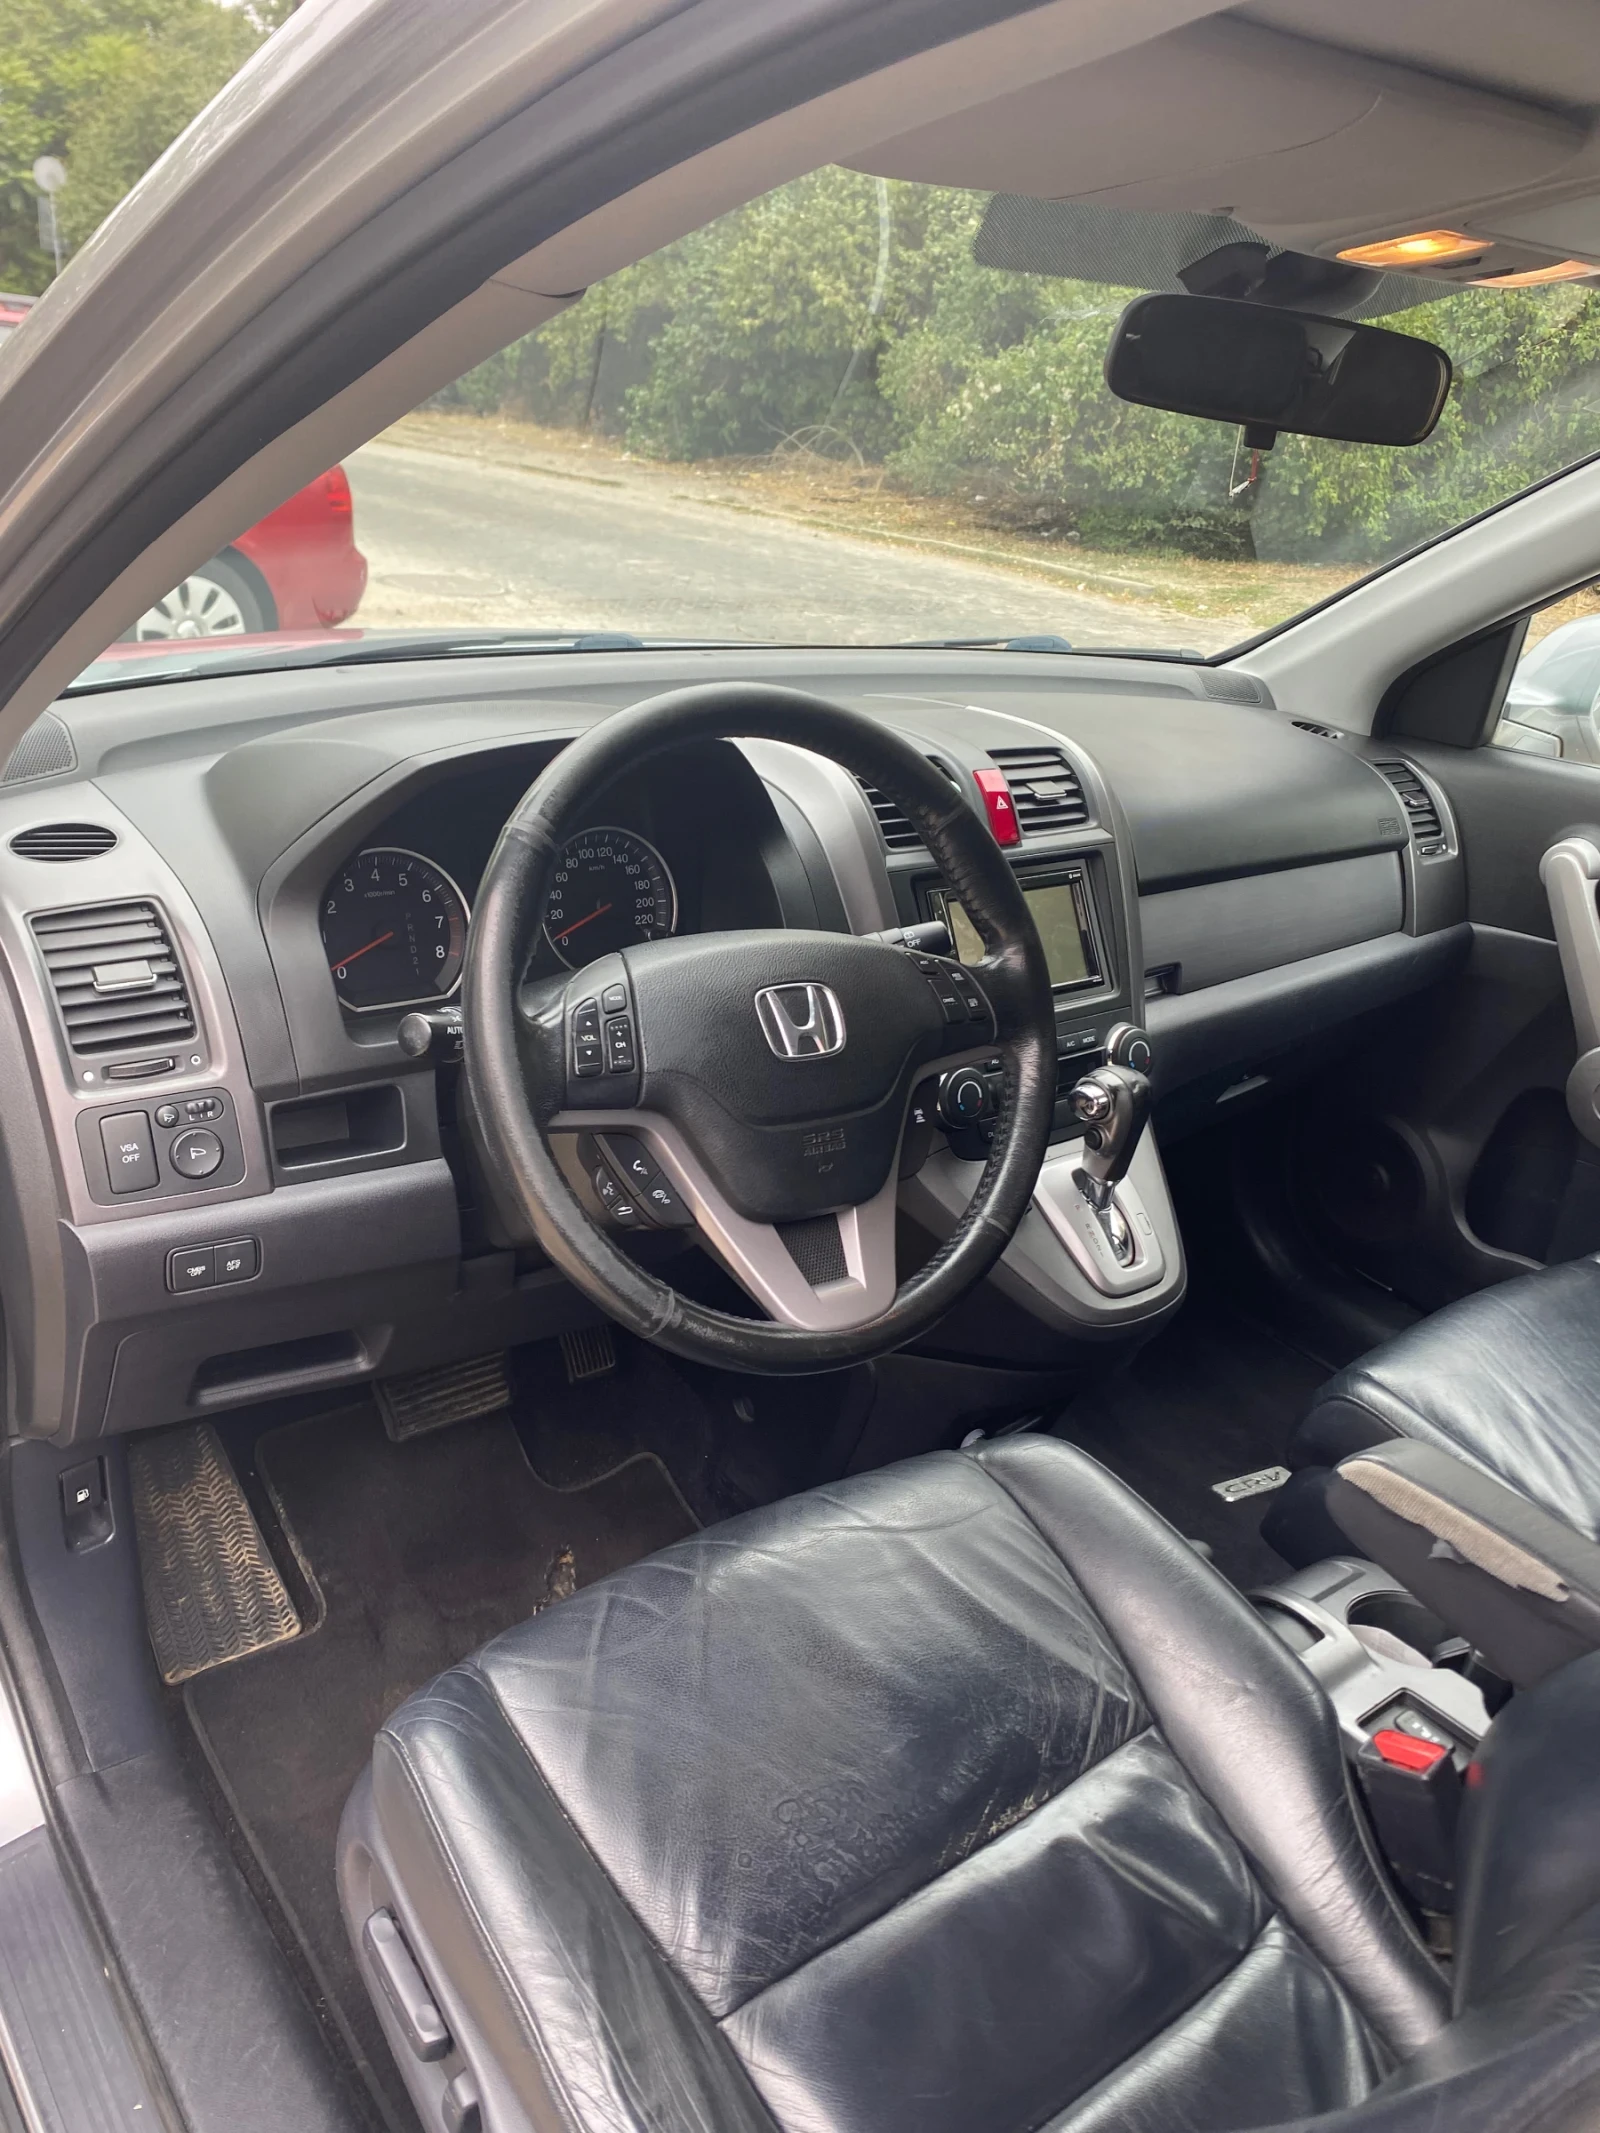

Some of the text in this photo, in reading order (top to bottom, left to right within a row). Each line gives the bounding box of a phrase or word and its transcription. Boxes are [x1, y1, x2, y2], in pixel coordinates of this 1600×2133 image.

[578, 848, 594, 859] 100
[596, 846, 613, 857] 120
[565, 858, 579, 869] 80
[613, 853, 629, 864] 140
[371, 868, 380, 881] 4
[625, 864, 640, 875] 160
[398, 873, 408, 886] 5
[555, 872, 568, 882] 60
[344, 878, 354, 892] 3
[634, 880, 650, 890] 180
[422, 889, 432, 902] 6
[549, 890, 562, 900] 40
[327, 900, 337, 914] 2
[636, 897, 654, 908] 200
[550, 909, 563, 920] 20
[635, 914, 653, 925] 220
[435, 916, 444, 929] 7
[561, 936, 569, 946] 0
[906, 938, 921, 948] OFF
[435, 945, 445, 958] 8
[337, 966, 347, 979] 0
[615, 1041, 627, 1049] CH
[207, 1110, 214, 1118] R
[120, 1142, 139, 1152] VSA
[122, 1153, 140, 1164] OFF
